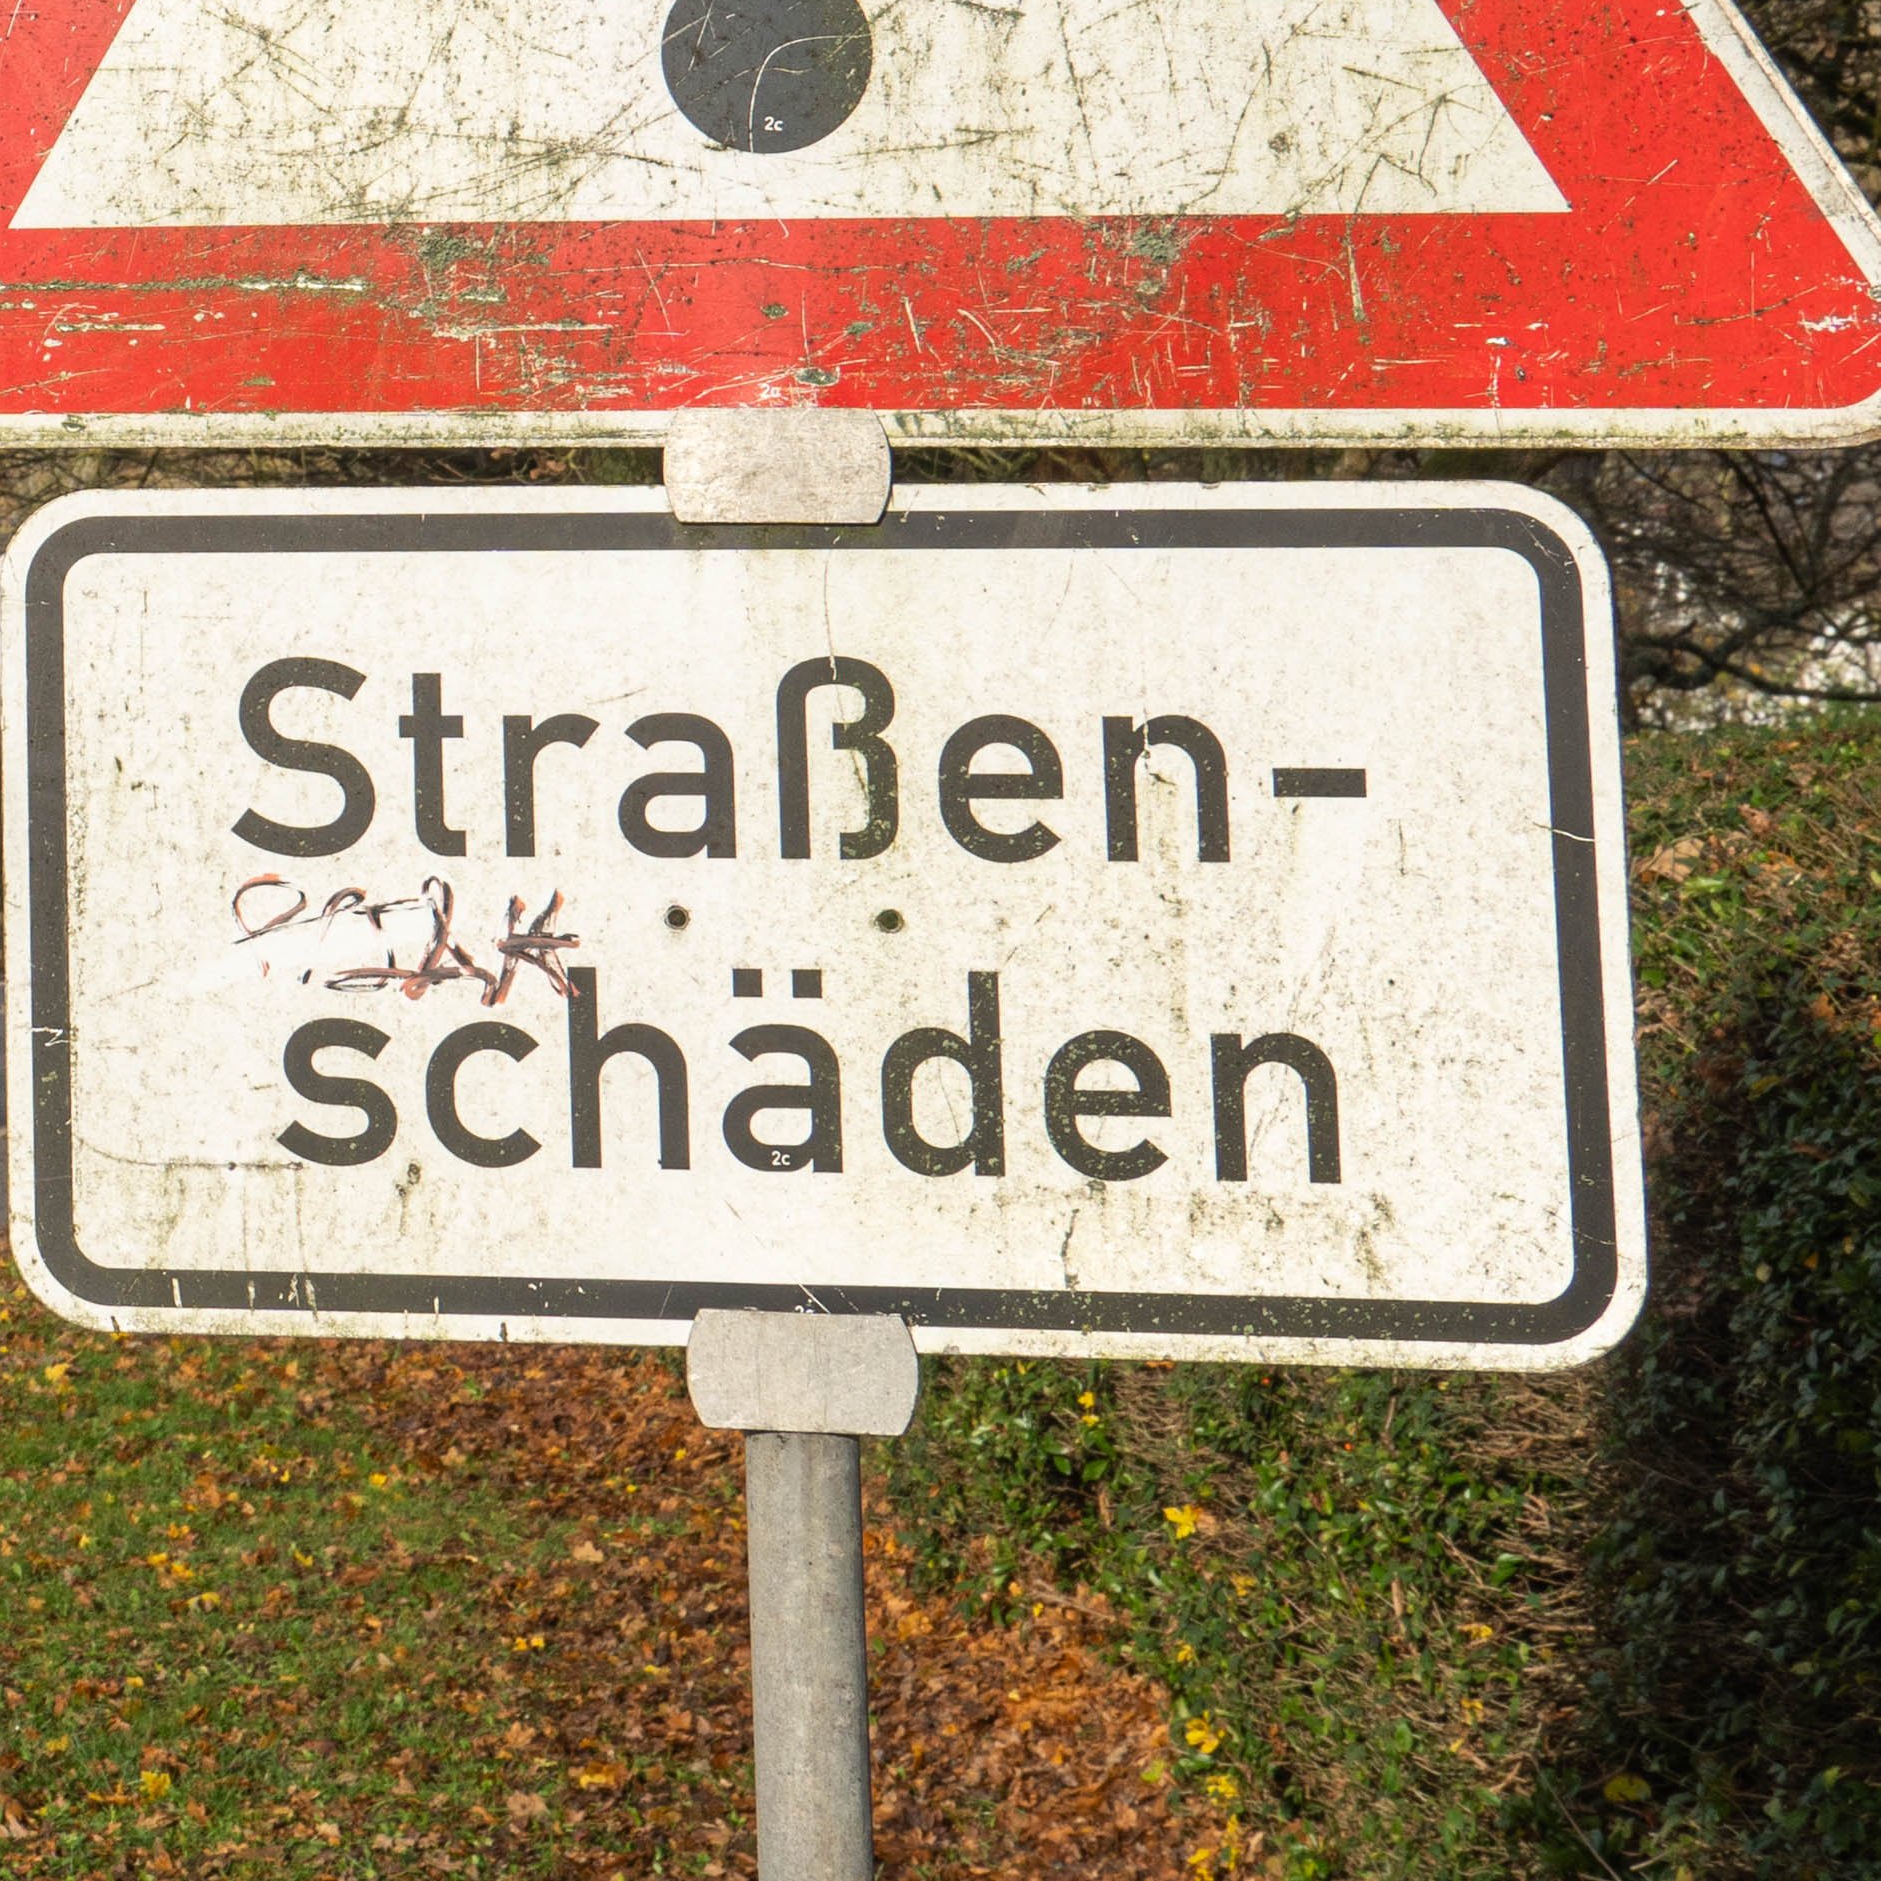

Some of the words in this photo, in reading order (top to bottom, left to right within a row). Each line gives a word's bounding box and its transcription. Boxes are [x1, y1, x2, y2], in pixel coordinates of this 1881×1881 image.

[764, 115, 784, 131] 2c
[230, 654, 1367, 865] Straßen-
[275, 967, 1343, 1185] schäden
[771, 1150, 791, 1166] 2c
